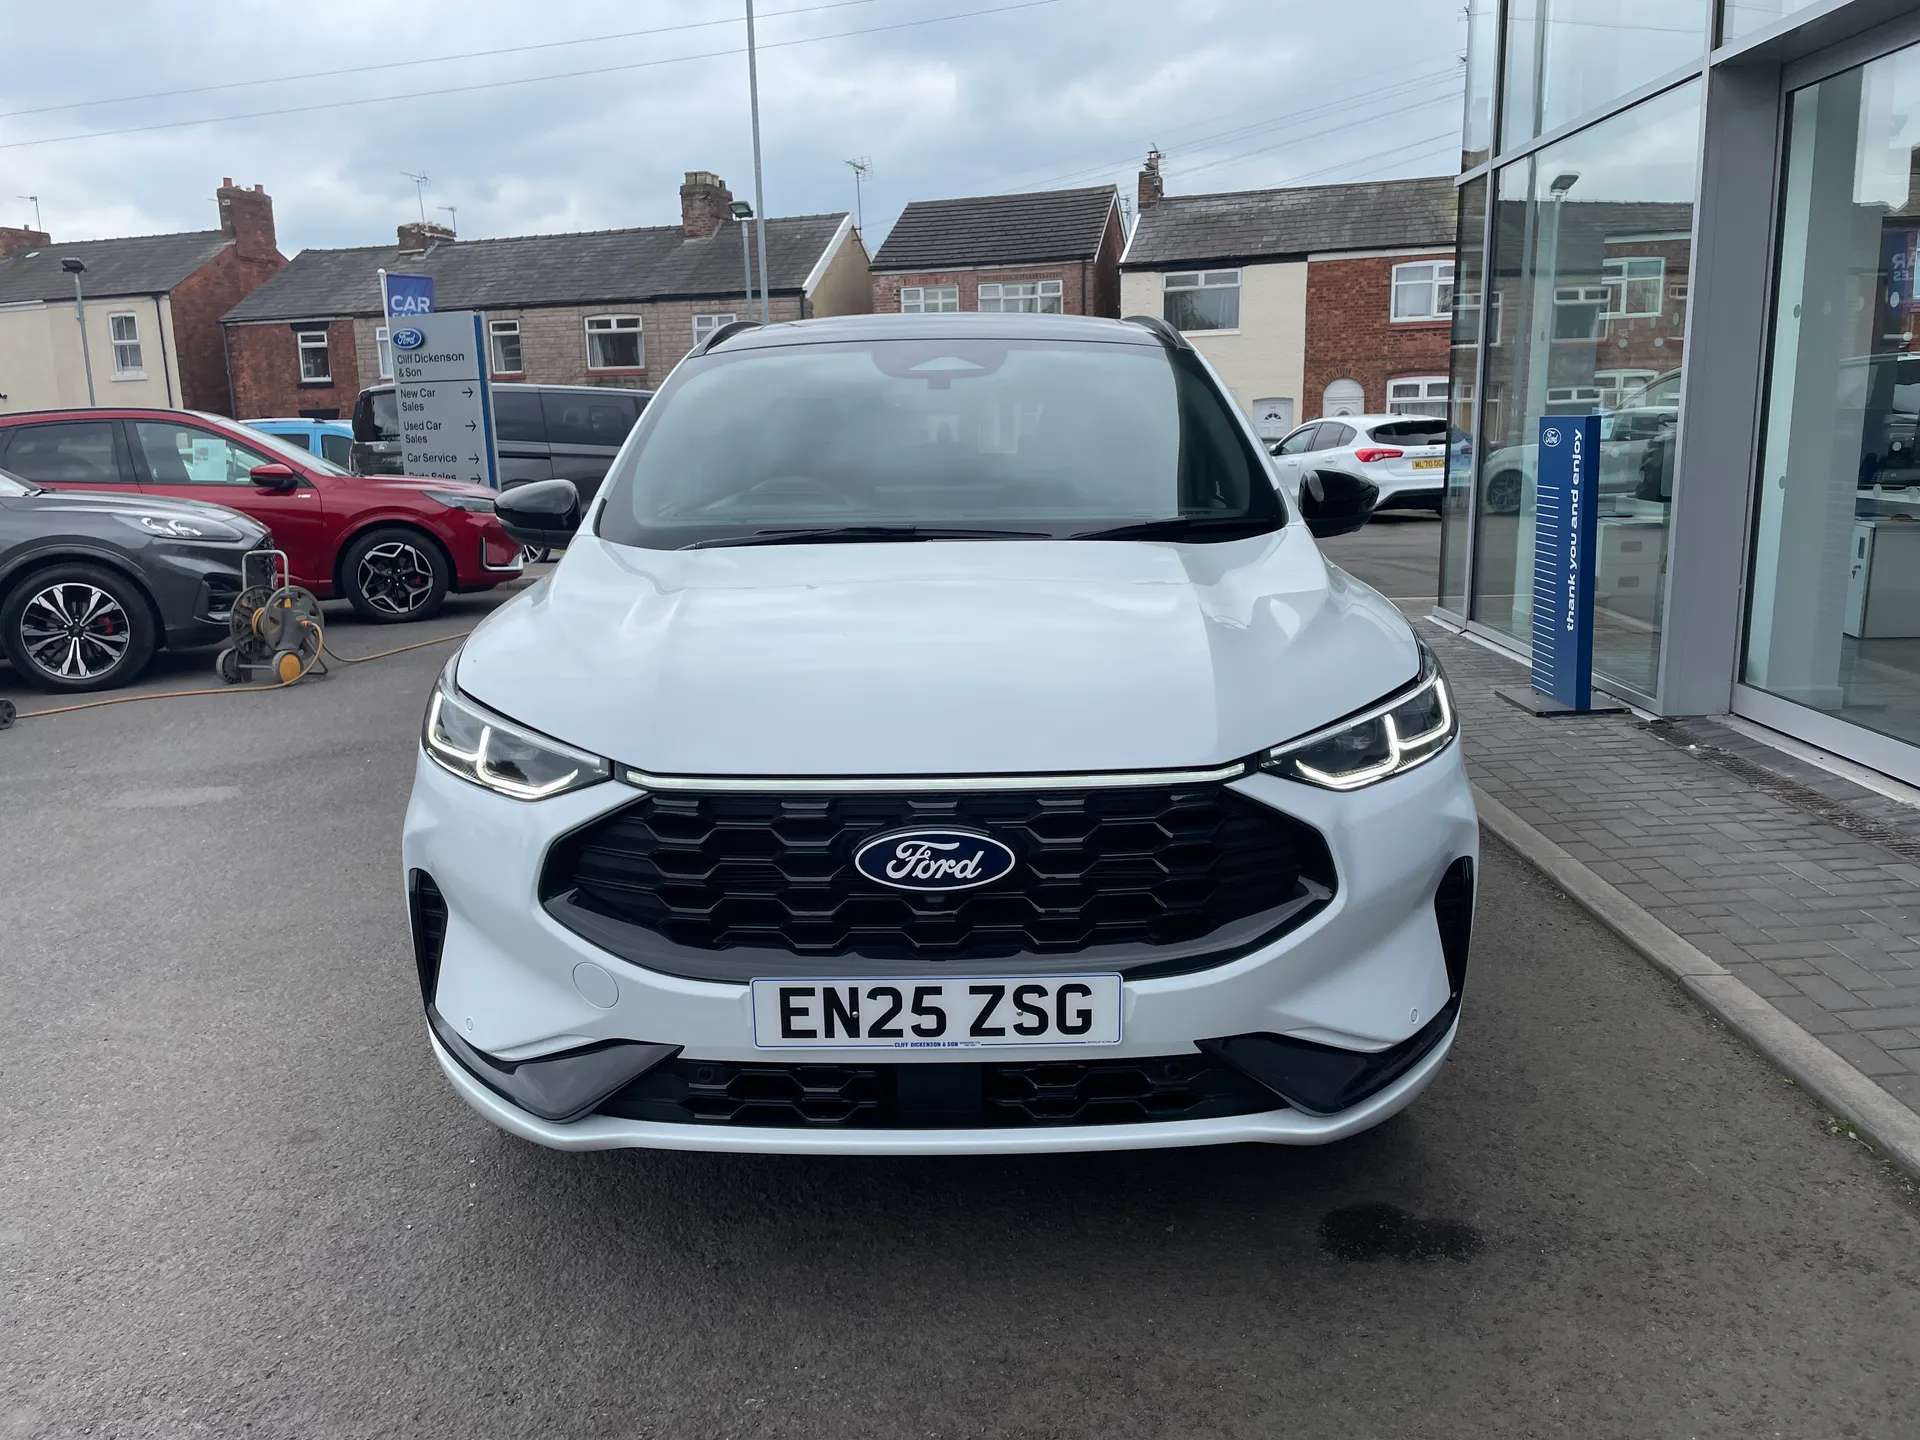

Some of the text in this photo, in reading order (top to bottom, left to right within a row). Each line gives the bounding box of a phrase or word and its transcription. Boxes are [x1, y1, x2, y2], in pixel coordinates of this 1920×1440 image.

[391, 295, 431, 313] CAR
[397, 353, 465, 364] Cliff Dickenson
[398, 367, 422, 378] & Son
[400, 388, 436, 399] New Car
[401, 401, 425, 411] Sales
[404, 420, 442, 431] Used Car
[405, 434, 428, 444] Sales
[407, 453, 458, 463] Car Service
[1566, 428, 1582, 631] thank you and enjoy
[886, 840, 985, 879] Ford
[779, 983, 1093, 1039] EN25 ZSG
